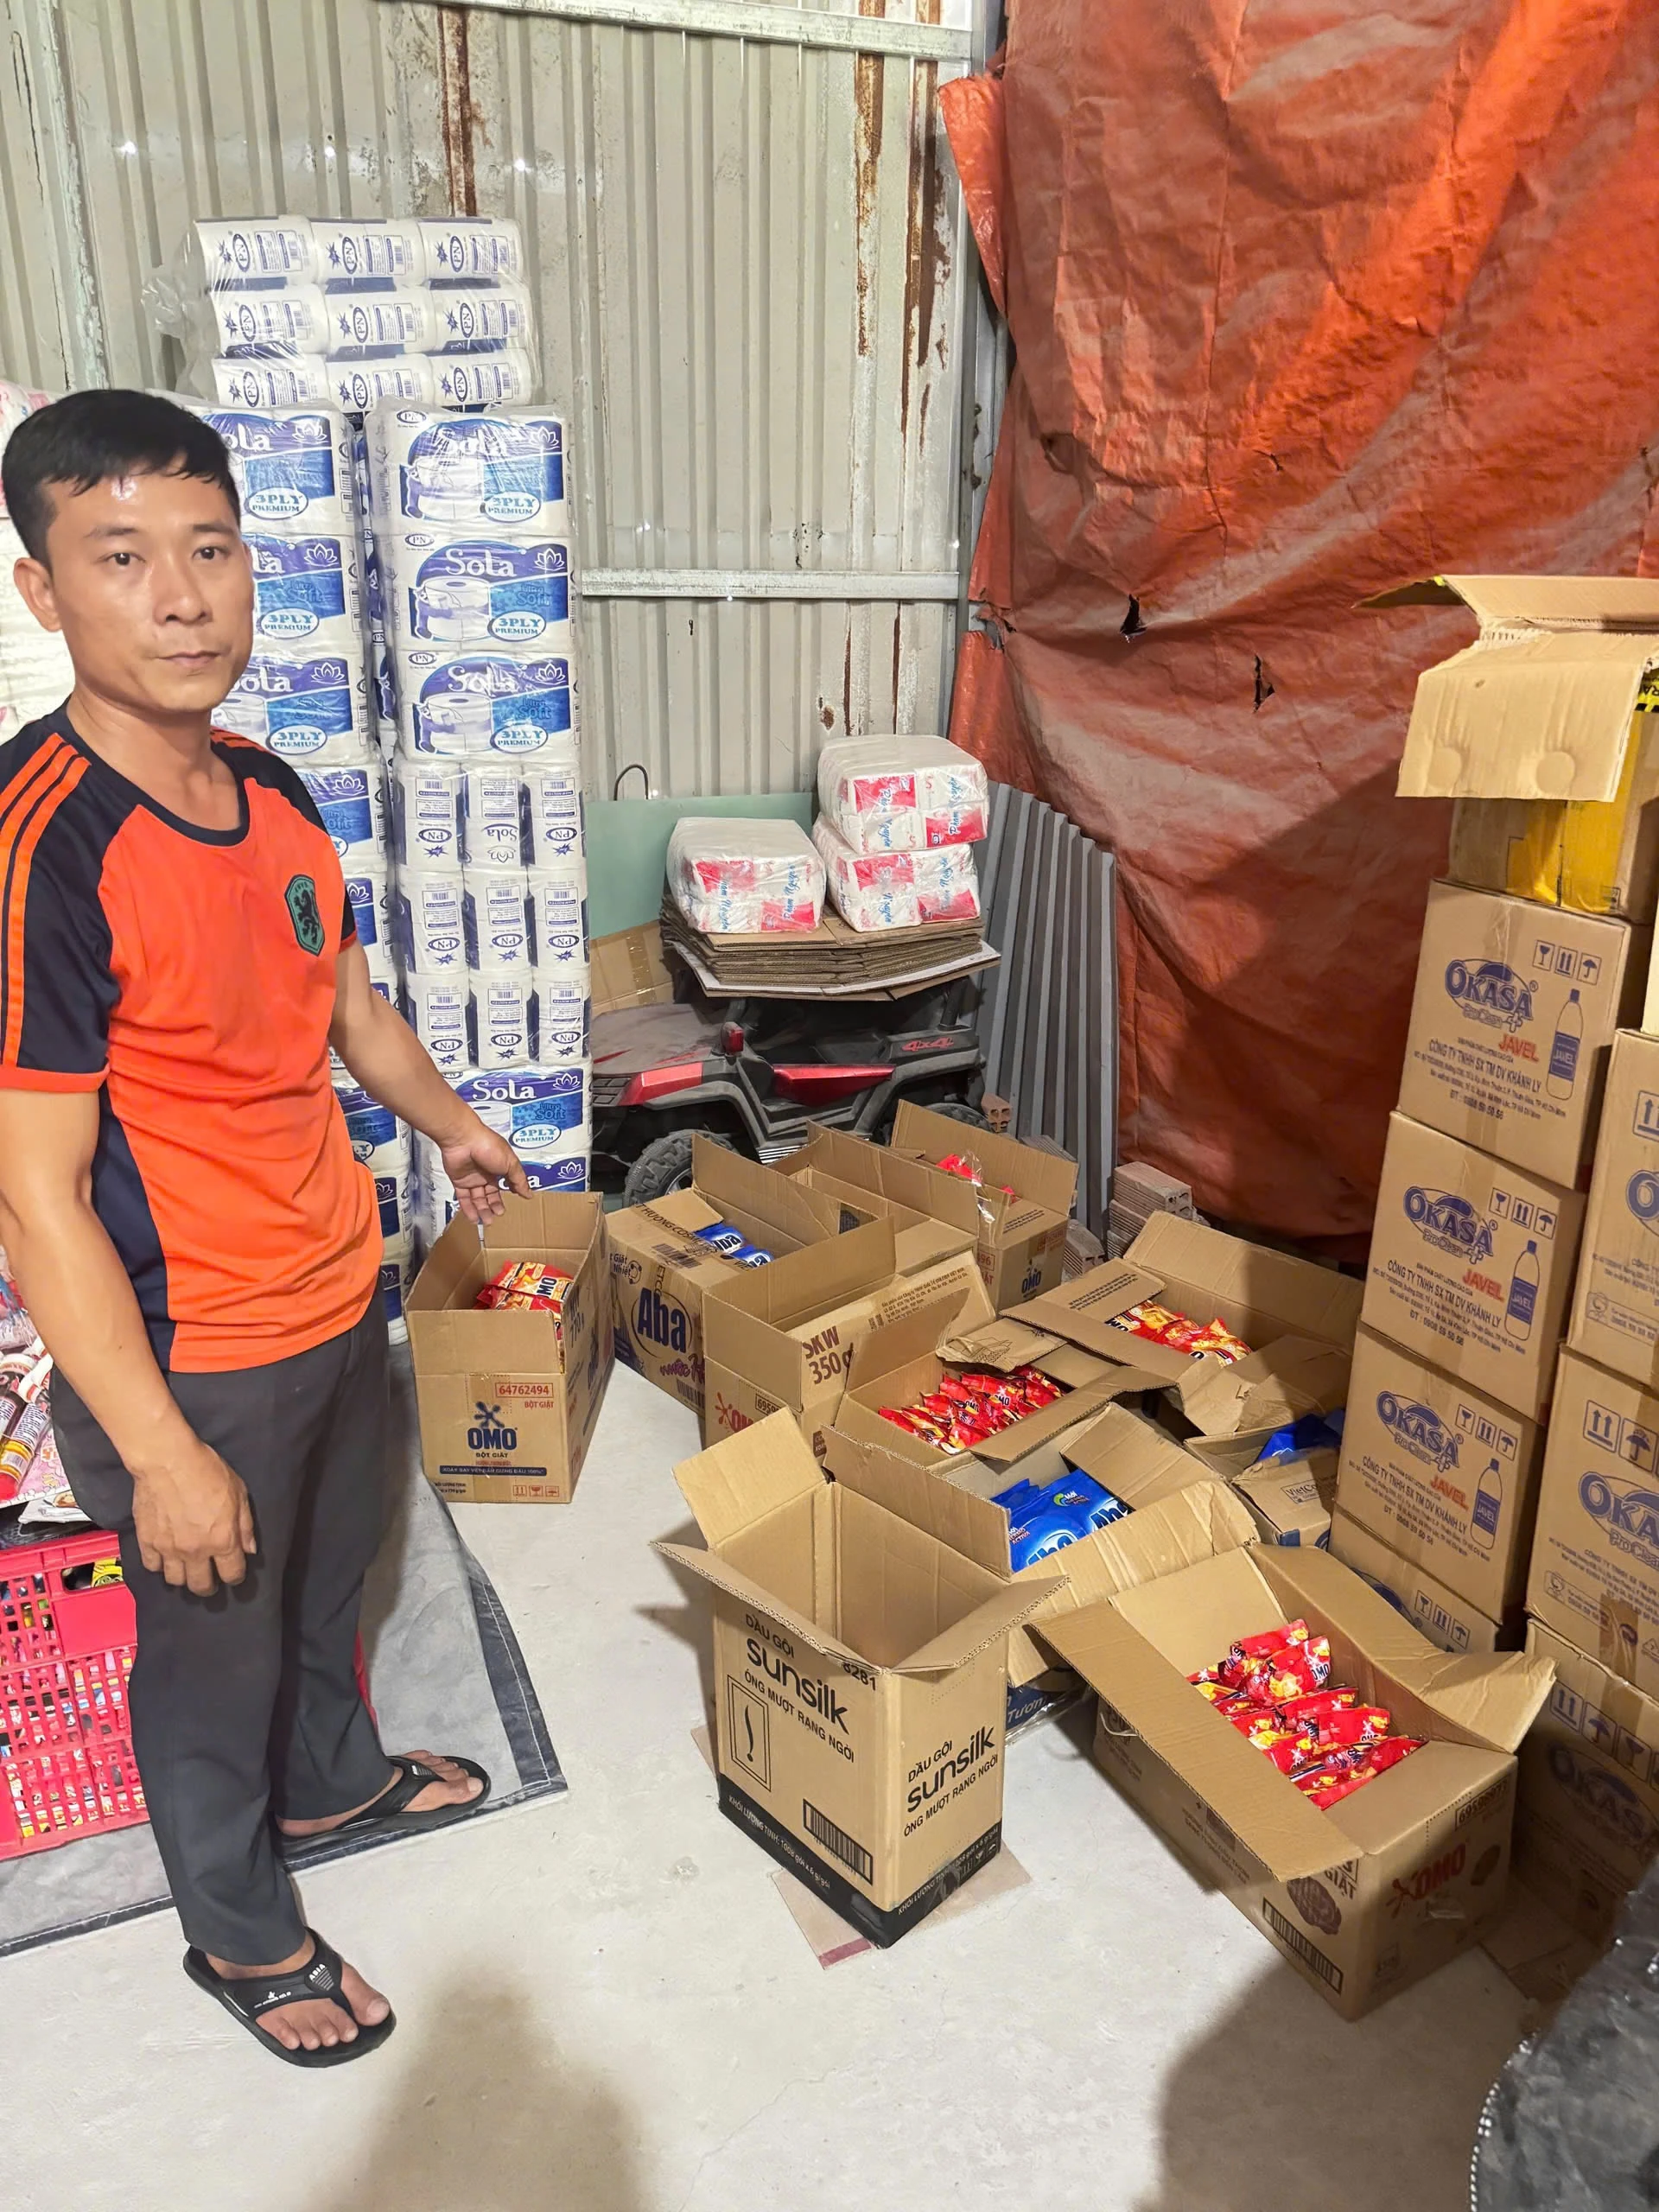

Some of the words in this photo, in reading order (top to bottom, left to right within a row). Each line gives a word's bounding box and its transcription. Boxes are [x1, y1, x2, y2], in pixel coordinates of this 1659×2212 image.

[358, 316, 365, 334] PN
[463, 313, 472, 329] PN
[358, 383, 365, 400] PN
[457, 379, 465, 393] PN
[226, 423, 273, 452] ola
[252, 504, 300, 512] PREMIUM
[255, 494, 302, 505] 3PLY
[493, 497, 536, 507] 3PLY
[445, 548, 517, 576] Sola
[268, 614, 315, 624] 3PLY
[499, 618, 542, 627] 3PLY
[415, 654, 429, 663] PN
[518, 706, 552, 720] Soft
[277, 732, 321, 741] 3PLY
[501, 730, 543, 739] 3PLY
[487, 830, 518, 842] Sola
[437, 939, 453, 949] PN
[501, 937, 516, 945] PN
[557, 937, 573, 945] PN
[1445, 959, 1534, 1020] OKASA
[560, 1033, 574, 1042] PN
[902, 1036, 956, 1052] 4x4
[1428, 1039, 1448, 1056] CÔNG
[1498, 1033, 1539, 1063] JAVEL
[1553, 1050, 1575, 1065] JAVEL
[473, 1080, 536, 1100] Sola
[536, 1109, 565, 1120] Soft
[515, 1134, 555, 1143] PREMIUM
[518, 1126, 557, 1136] 3PLY
[1403, 1185, 1493, 1256] OKASA
[1021, 1270, 1041, 1294] OMO
[1387, 1259, 1407, 1278] CÔNG
[1406, 1268, 1414, 1282] TY
[1416, 1274, 1434, 1294] TNHH
[1466, 1299, 1491, 1323] KHÁNH
[1462, 1268, 1504, 1303] JAVEL
[1512, 1294, 1532, 1309] JAVEL
[637, 1287, 687, 1354] Aba
[801, 1325, 840, 1360] SKW
[808, 1352, 842, 1386] 350
[499, 1384, 550, 1395] 64762494
[1376, 1390, 1459, 1468] OKASA
[467, 1427, 517, 1450] OMO
[1362, 1455, 1380, 1477] CÔNG
[1430, 1474, 1469, 1512] JAVEL
[1579, 1470, 1659, 1548] OKA
[746, 1612, 770, 1642] DẦU
[772, 1630, 795, 1659] GỘI
[1311, 1663, 1331, 1681] OMO
[747, 1637, 849, 1735] sunsilk
[745, 1672, 766, 1694] ÓNG
[767, 1688, 795, 1718] MƯỢT
[797, 1707, 826, 1743] RẠNG
[828, 1733, 855, 1763] NGỜI
[907, 1726, 995, 1813] sunsilk
[908, 1760, 931, 1783] DẦU
[934, 1740, 953, 1766] GỘI
[904, 1815, 924, 1837] ÓNG
[925, 1795, 950, 1820] MƯỢT
[952, 1772, 976, 1801] RẠNG
[977, 1754, 998, 1783] NGỜI
[1412, 1842, 1465, 1900] OMO
